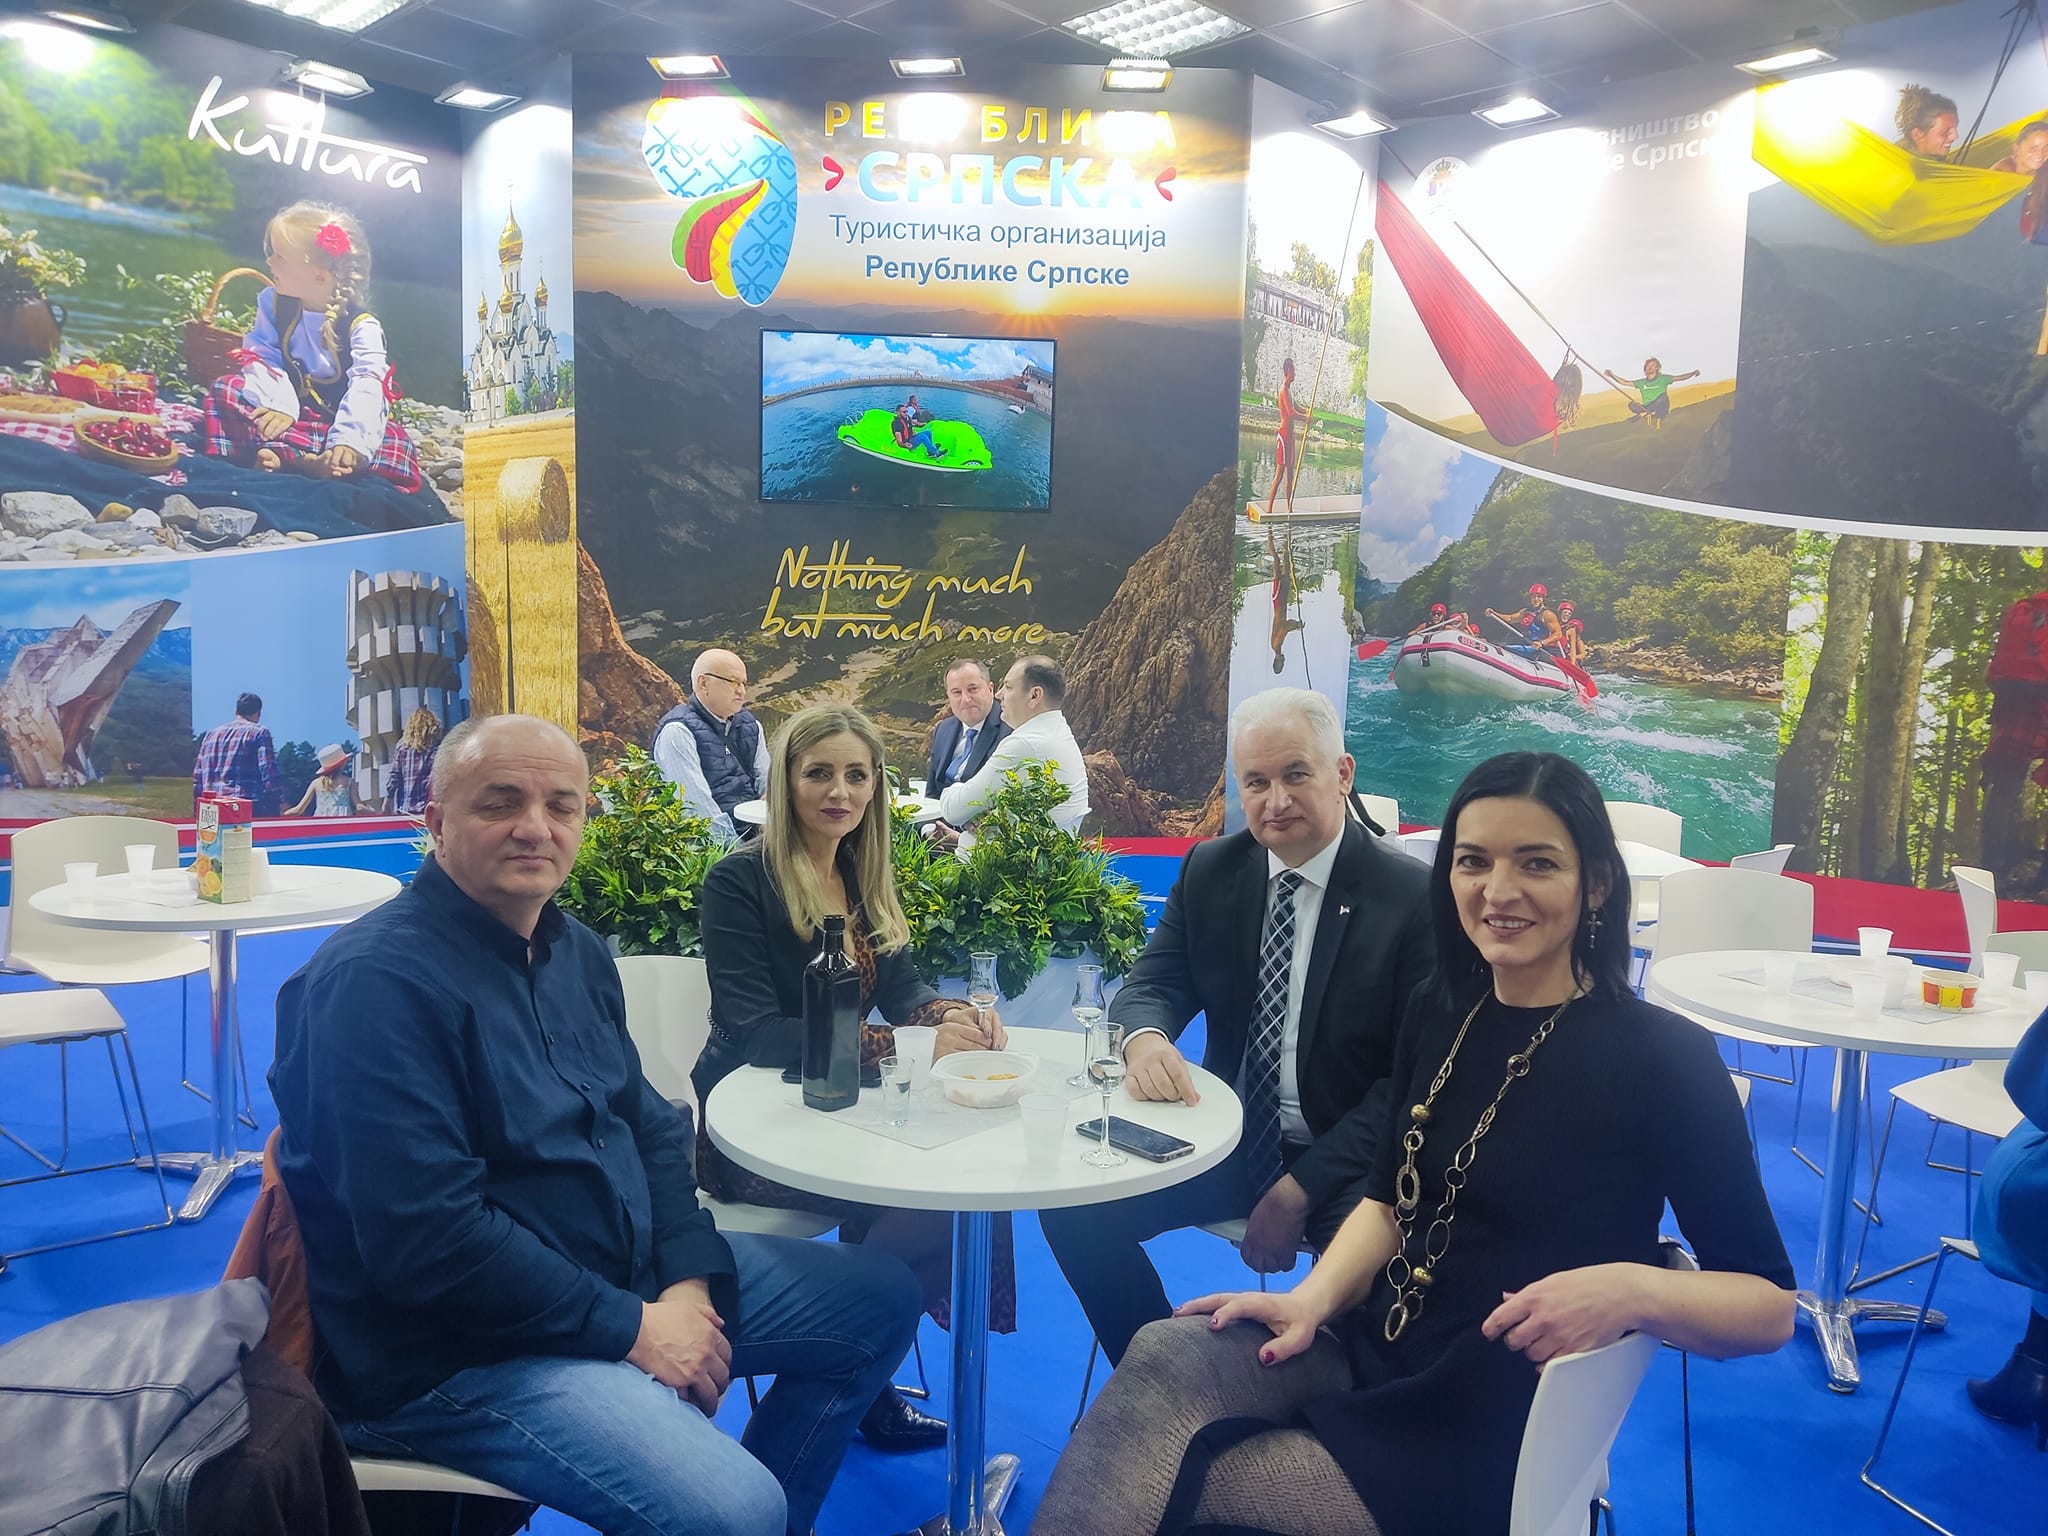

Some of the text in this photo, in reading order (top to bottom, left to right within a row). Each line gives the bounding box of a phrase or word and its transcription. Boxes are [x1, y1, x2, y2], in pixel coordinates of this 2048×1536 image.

[823, 101, 1177, 148] РЕБЛИА
[857, 150, 1144, 208] СРПСКА
[828, 214, 1167, 250] Туристичка организација
[864, 255, 1130, 288] Републике Српске
[776, 539, 1033, 608] Nothing much
[836, 591, 944, 642] much
[956, 622, 1048, 645] more
